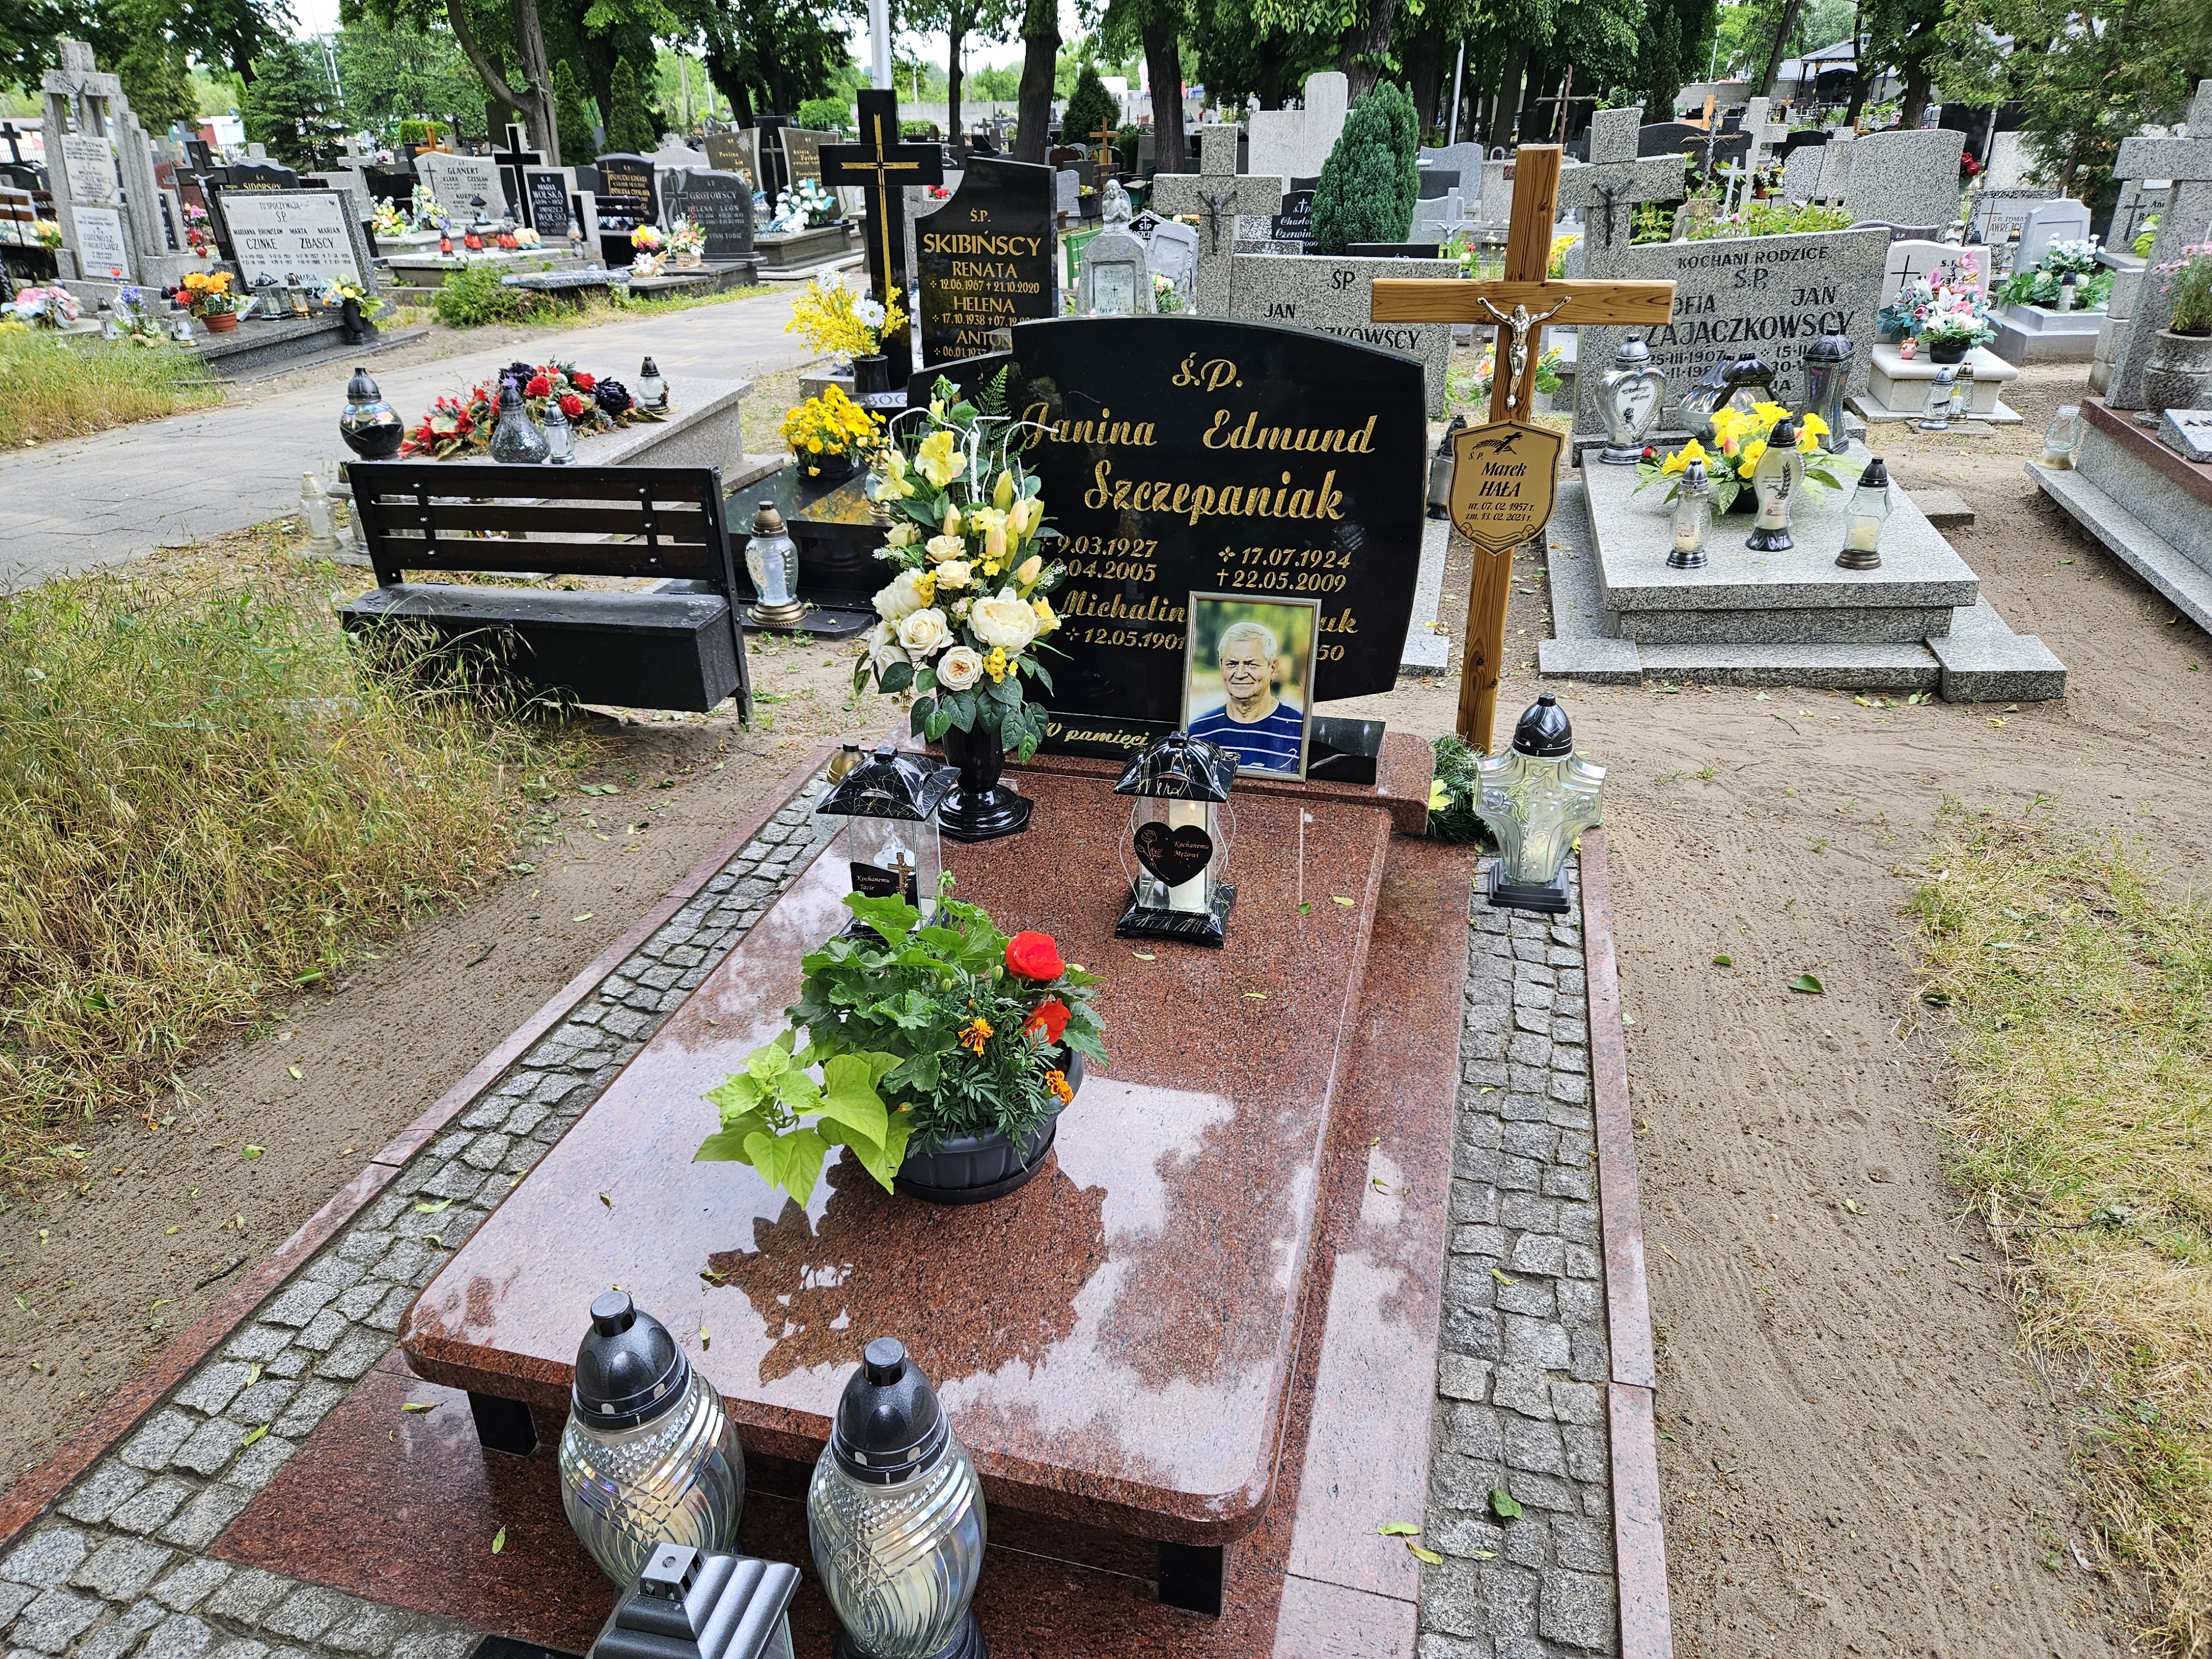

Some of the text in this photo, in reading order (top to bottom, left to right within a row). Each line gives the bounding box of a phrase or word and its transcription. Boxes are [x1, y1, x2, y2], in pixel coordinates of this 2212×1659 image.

[532, 190, 564, 200] WOLSKA
[971, 208, 991, 222] Ś.P.
[84, 233, 113, 243] EUGENIUSZ
[246, 238, 278, 249] CZINKE
[924, 230, 1041, 257] SKIBIŃSCY
[1679, 247, 1829, 270] KOCHANI RODZICE
[952, 261, 1018, 279] RENATA
[940, 279, 1040, 294] 12.06.1967 21.10.2020
[954, 296, 1015, 314] HELENA
[1673, 286, 1835, 315] OFIA JAN
[942, 313, 985, 325] 17.10.1938
[1264, 304, 1295, 319] JAN
[1021, 402, 1378, 453] Janina Edmund
[1481, 462, 1527, 477] Marek
[1084, 460, 1346, 526] Szczepaniak
[1478, 481, 1522, 497] HAŁA
[1495, 502, 1506, 510] 02.
[1509, 503, 1529, 511] 1957
[1242, 546, 1353, 569] 17.07.1924
[1232, 570, 1347, 593] 22.05.2009
[1055, 589, 1187, 623] Michalin
[1064, 729, 1150, 749] pamięci
[1173, 841, 1209, 849] Kochanemu
[1173, 850, 1200, 858] Mężowi
[857, 875, 890, 884] Kochanemu
